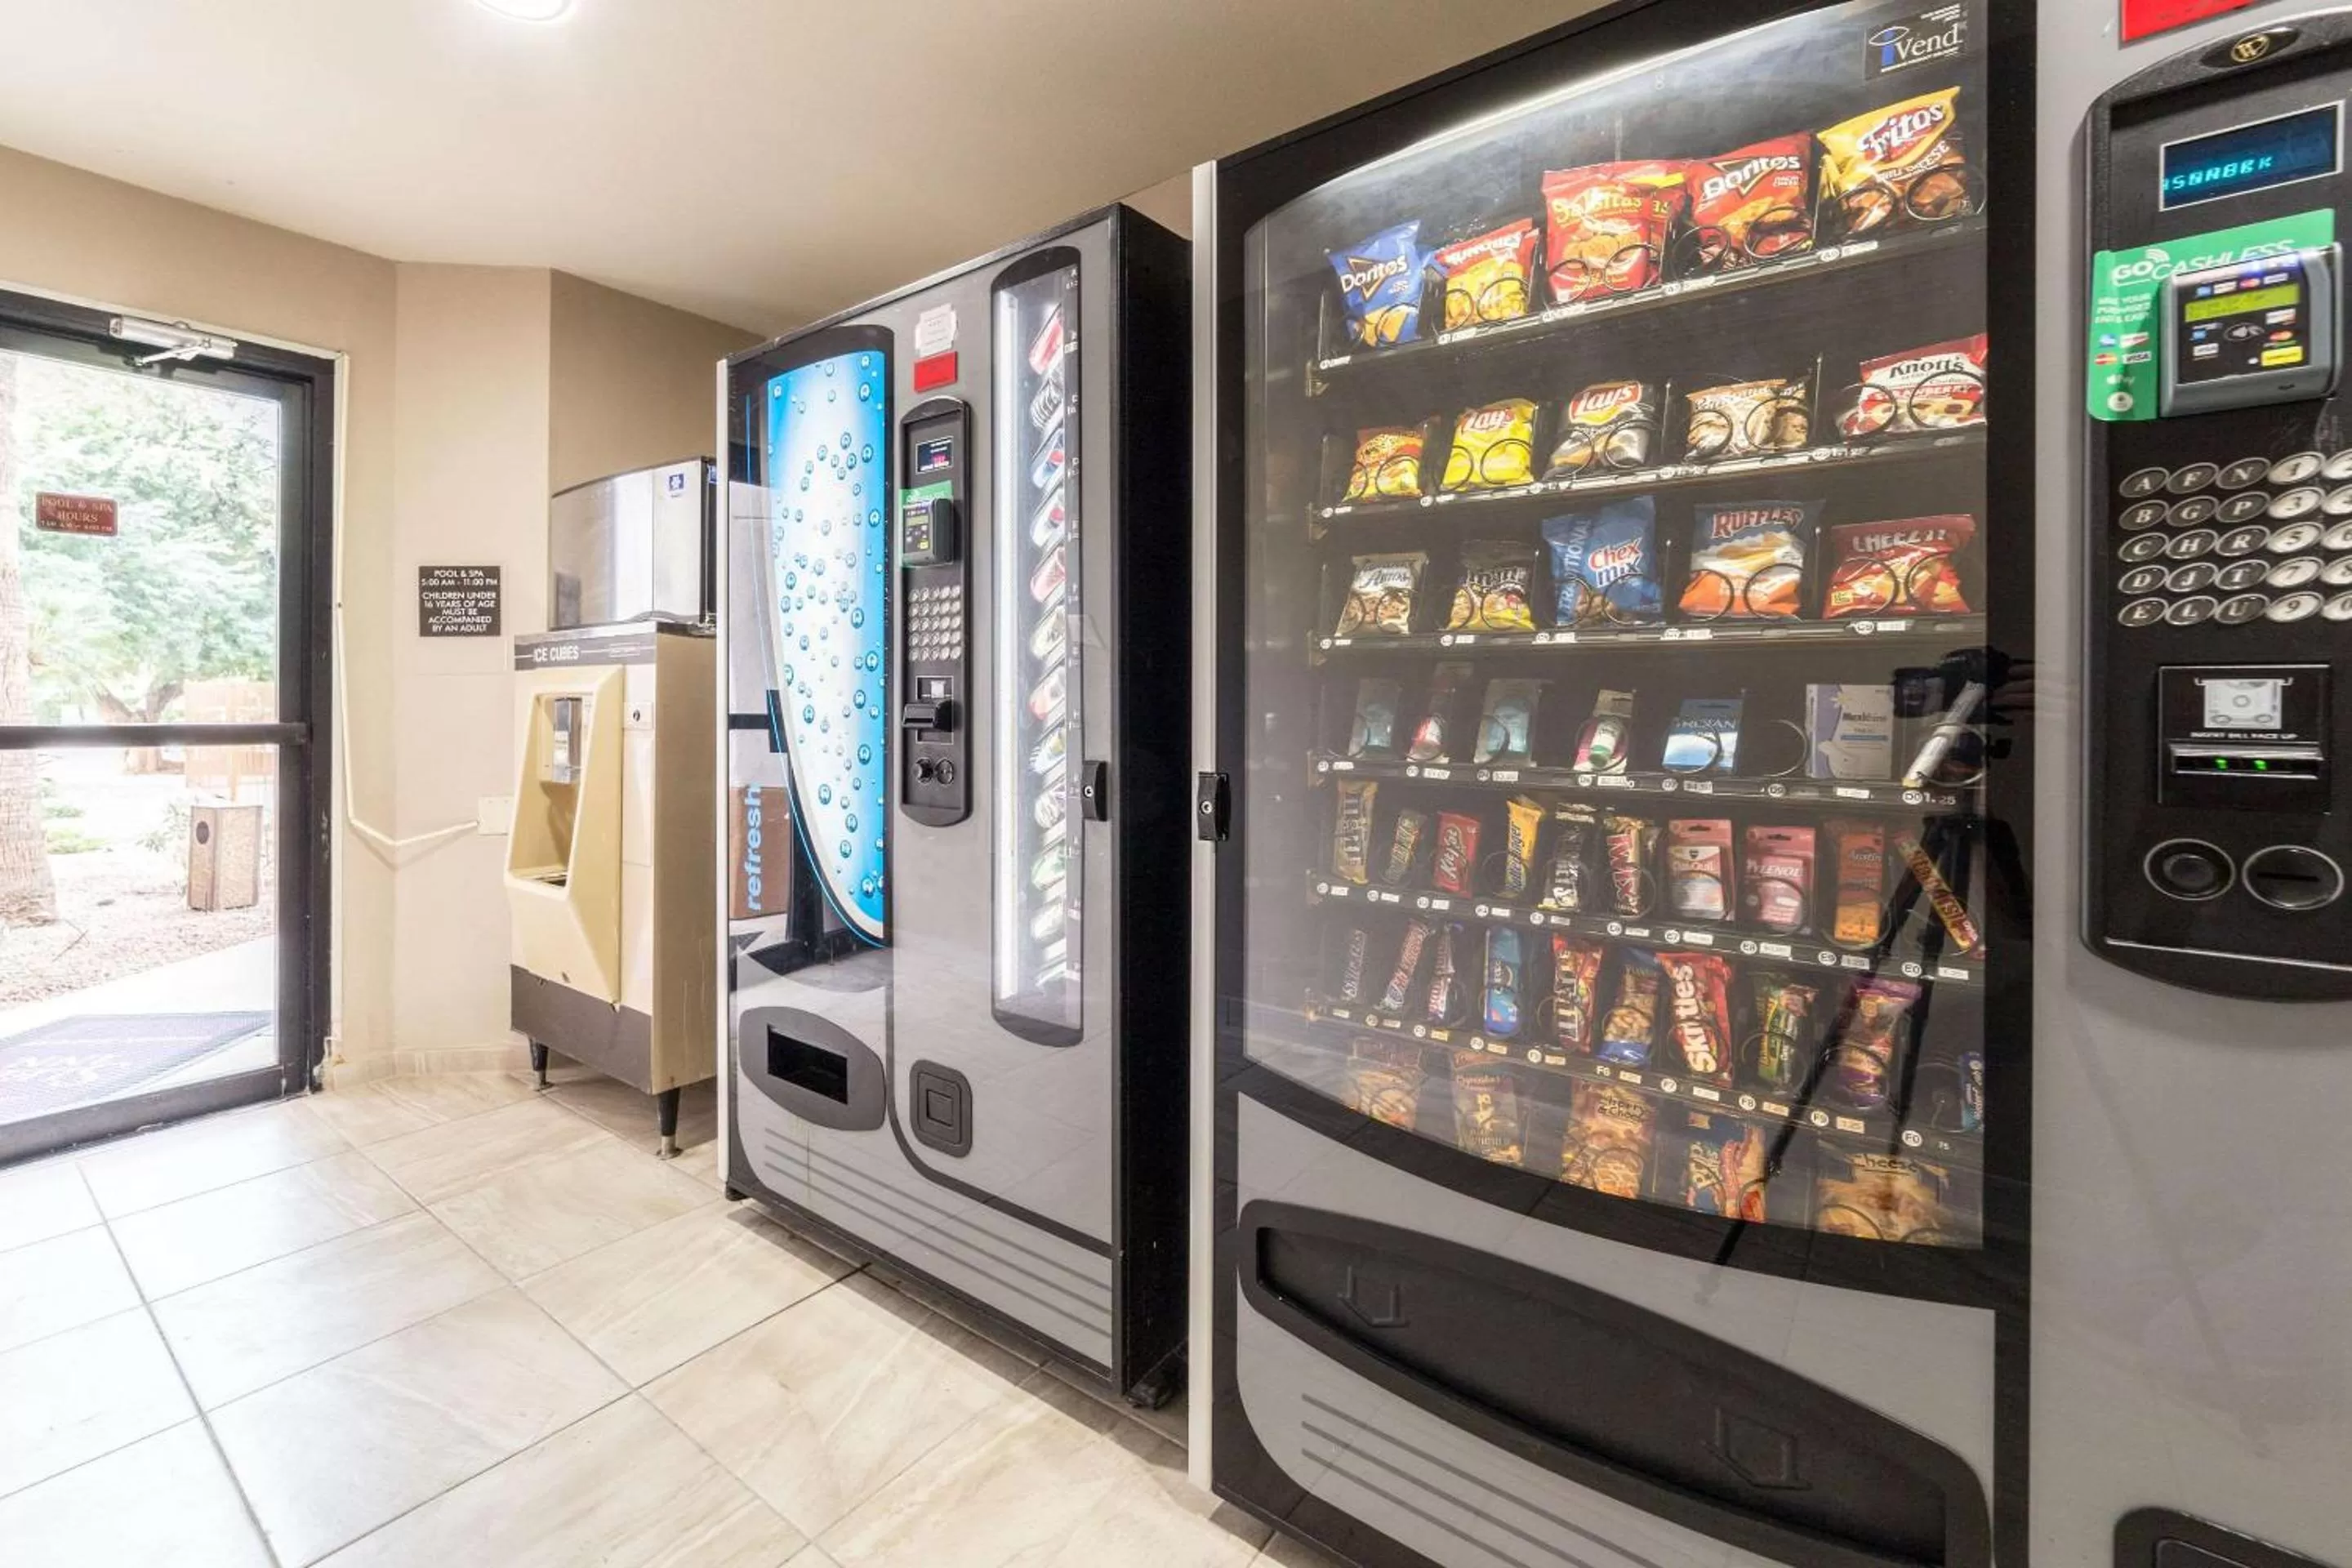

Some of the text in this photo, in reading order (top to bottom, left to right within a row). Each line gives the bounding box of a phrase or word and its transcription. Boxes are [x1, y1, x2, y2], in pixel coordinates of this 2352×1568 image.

[1856, 103, 1944, 162] Fritos
[1704, 155, 1801, 200] Doritos
[1340, 255, 1407, 293] Doritos
[2136, 477, 2151, 491] A
[2183, 470, 2202, 488] F
[2234, 466, 2253, 482] N
[2136, 509, 2153, 523] B
[2180, 505, 2201, 519] G
[2233, 500, 2252, 516] P
[1588, 542, 1640, 570] Chex
[2133, 541, 2151, 555] C
[2179, 537, 2201, 553] H
[2233, 533, 2252, 549] R
[2133, 573, 2152, 588] D
[2180, 571, 2197, 586] J
[2133, 604, 2151, 619] E
[2181, 603, 2198, 617] L
[2229, 600, 2248, 617] U
[460, 624, 487, 632] ADULT
[533, 645, 579, 662] ICE CUBES
[744, 781, 761, 911] refresh
